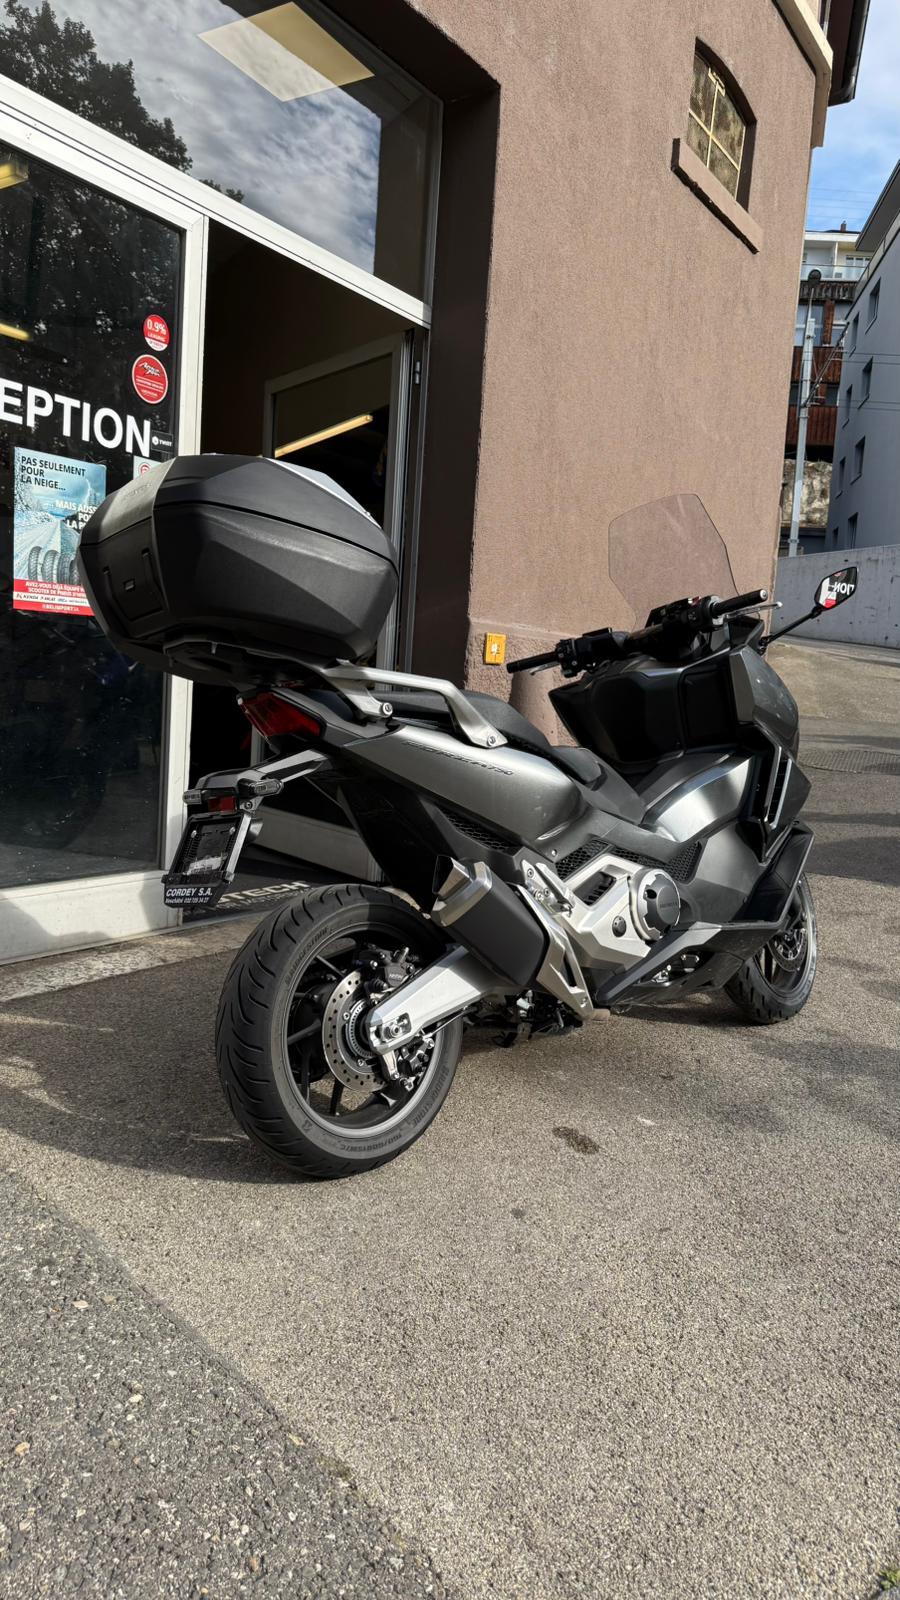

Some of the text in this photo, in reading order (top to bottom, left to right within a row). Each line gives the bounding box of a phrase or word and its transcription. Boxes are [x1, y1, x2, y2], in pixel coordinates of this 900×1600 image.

[147, 319, 167, 335] 0.9%
[0, 377, 151, 458] EPTION
[21, 456, 86, 477] PAS SEULEMENT
[21, 465, 45, 478] POUR
[21, 475, 32, 485] LA
[56, 500, 77, 511] MAIS
[67, 519, 78, 529] LA
[166, 887, 213, 897] CORDEY S.A.
